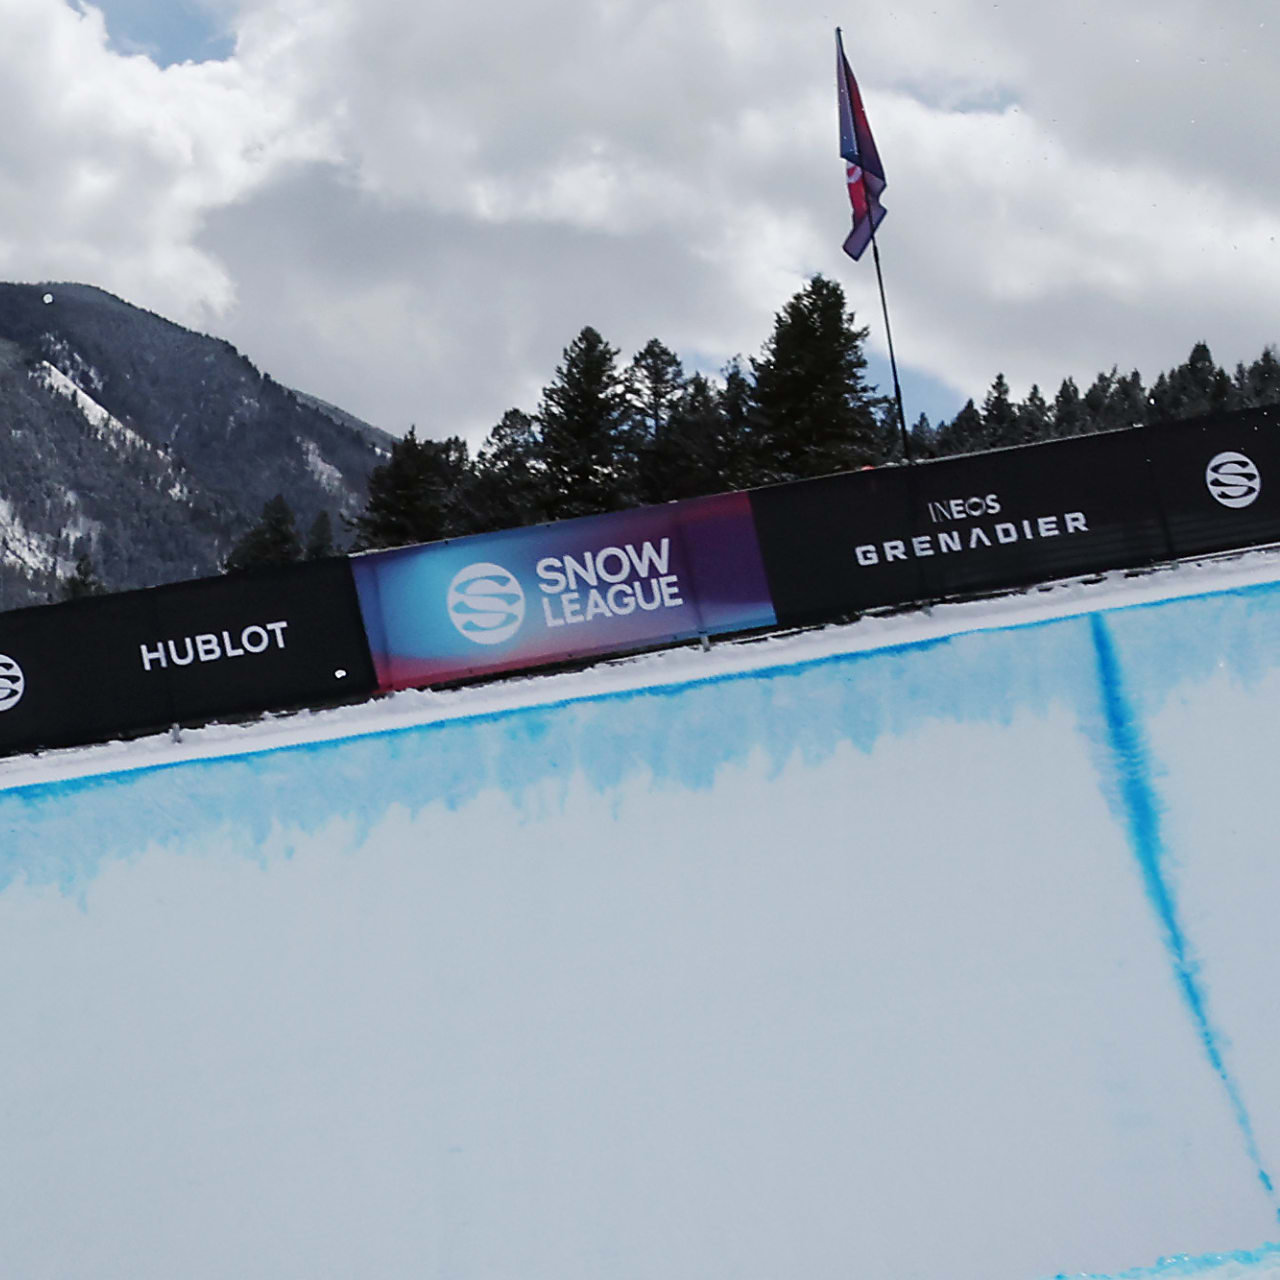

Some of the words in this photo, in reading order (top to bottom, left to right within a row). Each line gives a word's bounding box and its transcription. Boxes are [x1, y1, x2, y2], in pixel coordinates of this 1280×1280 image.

[928, 494, 1002, 523] INEOS
[855, 511, 1090, 567] GRENADIER
[536, 537, 670, 595] SNOW
[541, 575, 683, 628] LEAGUE
[140, 621, 288, 671] HUBLOT
